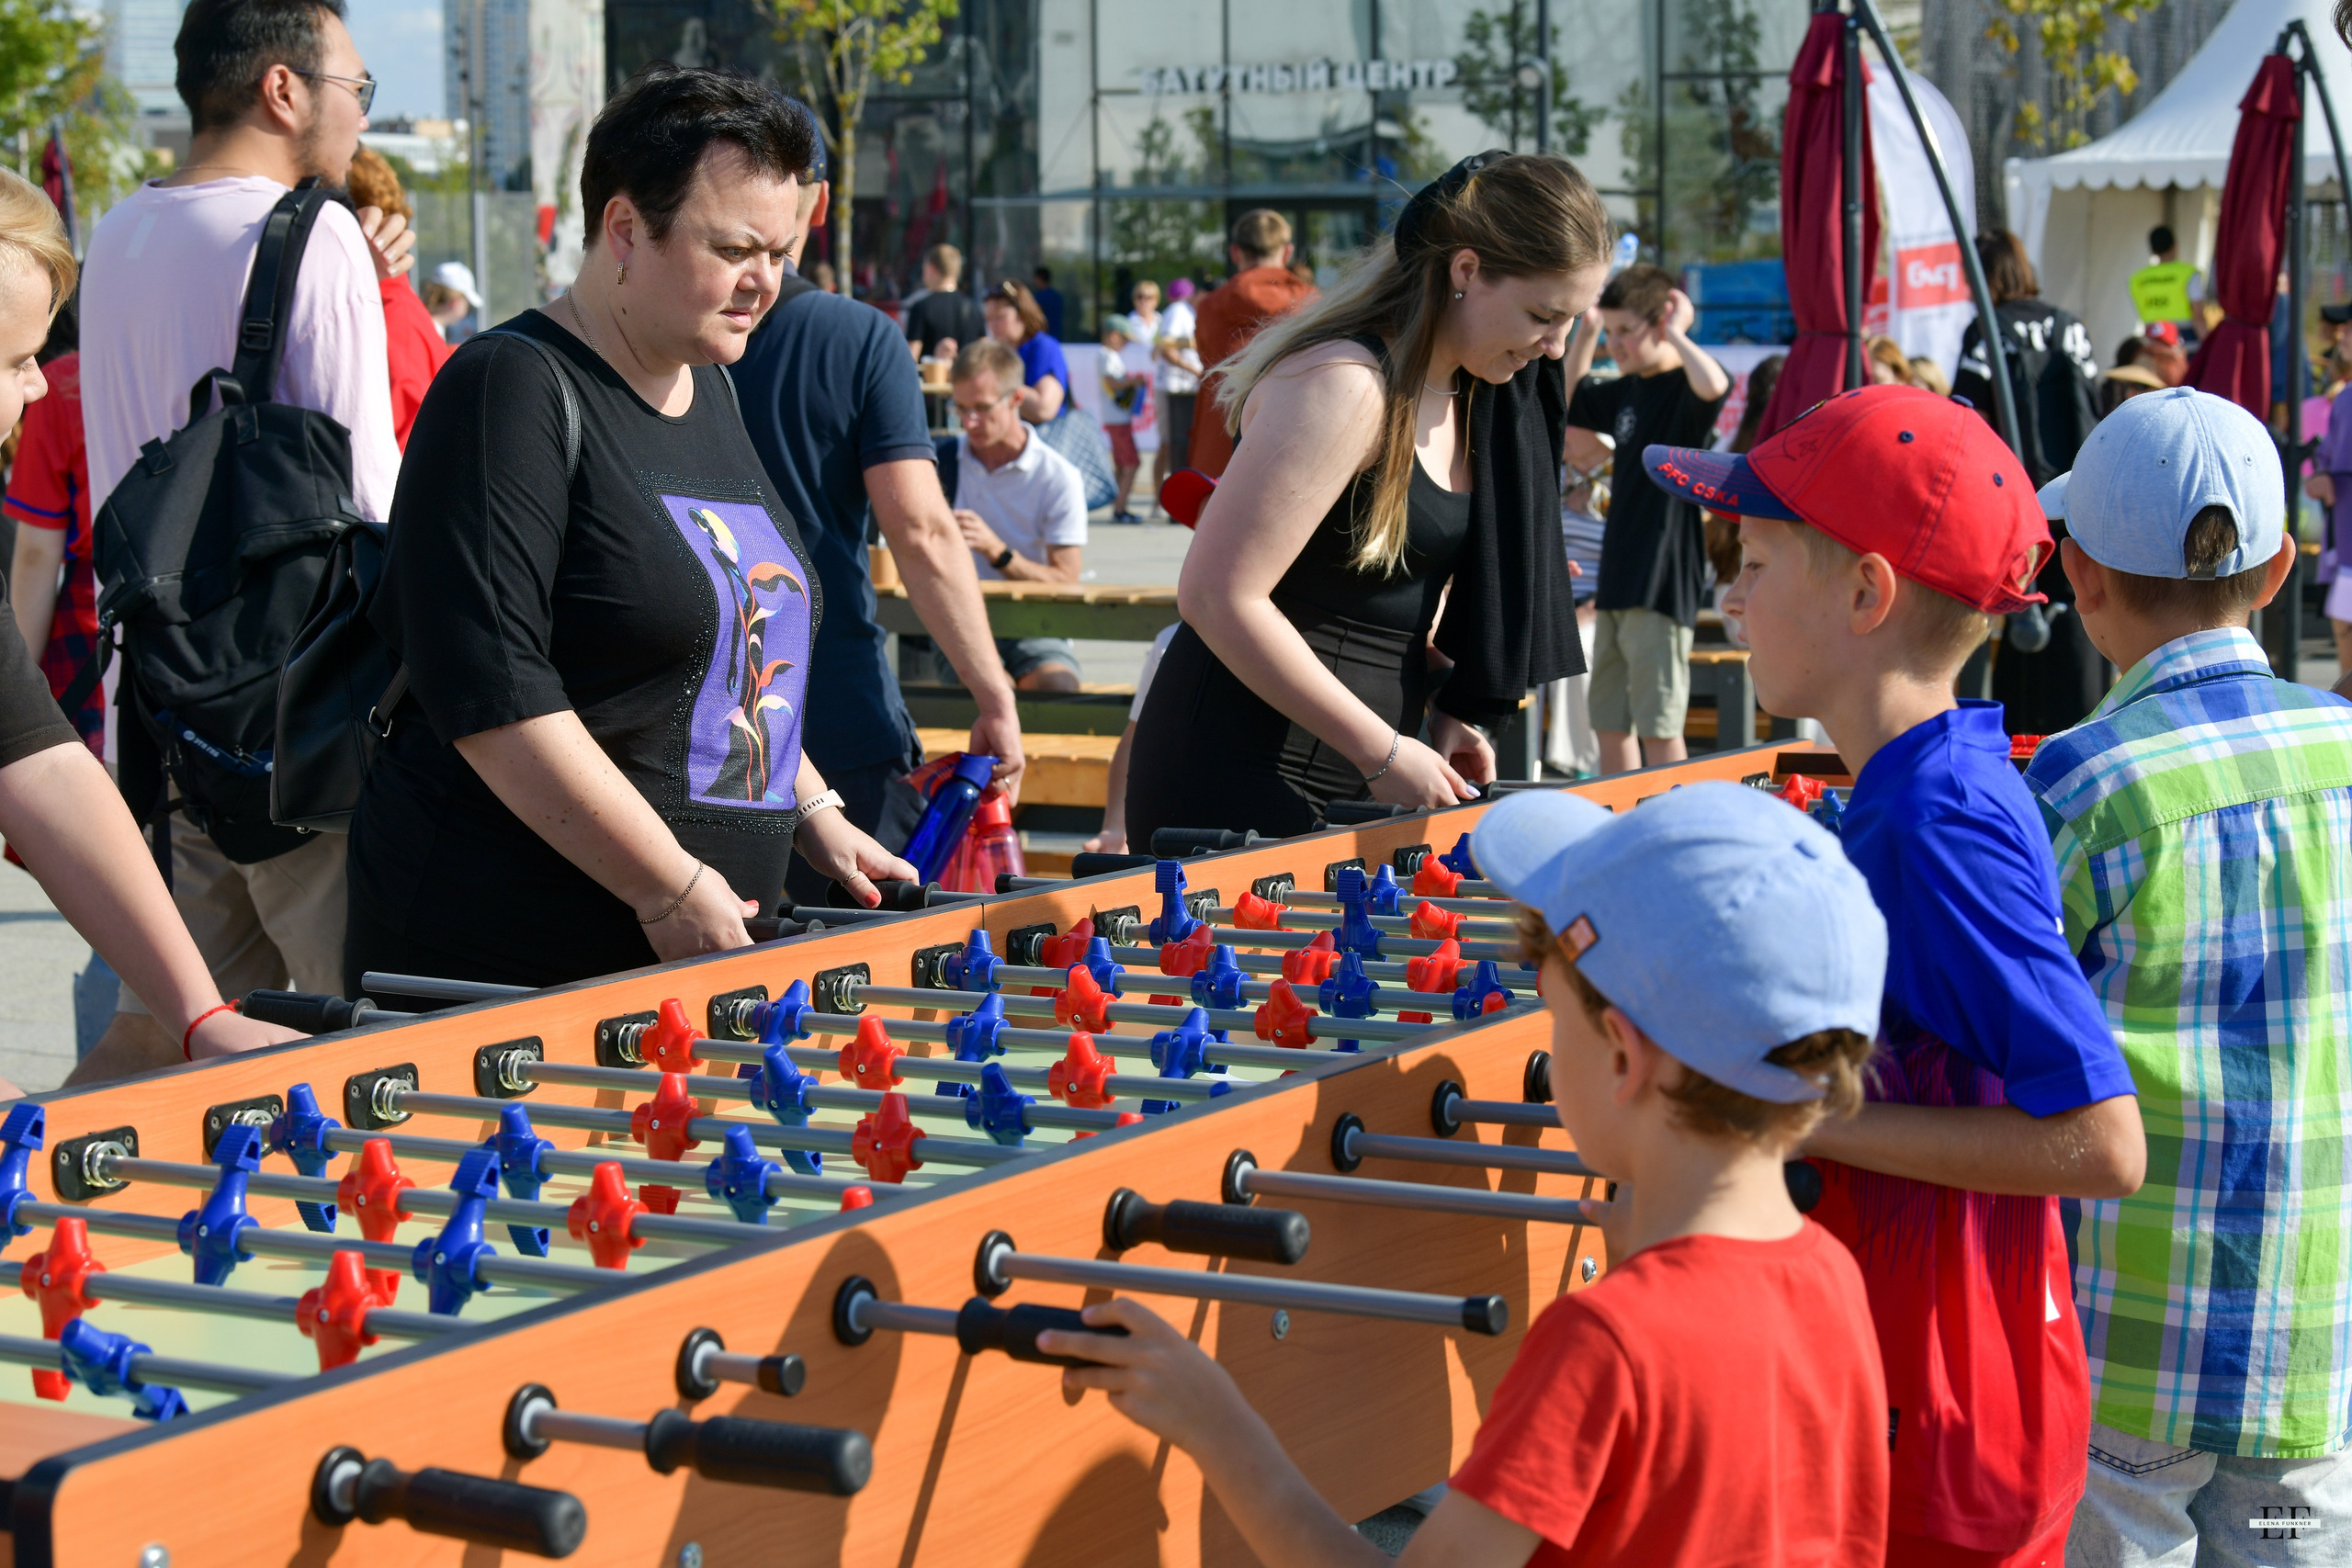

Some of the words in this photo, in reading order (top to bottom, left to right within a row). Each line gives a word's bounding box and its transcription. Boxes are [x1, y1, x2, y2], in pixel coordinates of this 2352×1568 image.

[1140, 57, 1332, 92] БАТУТНЫЙ
[1339, 59, 1458, 91] ЦЕНТР
[1657, 462, 1690, 487] PFC
[1691, 481, 1738, 506] CSKA
